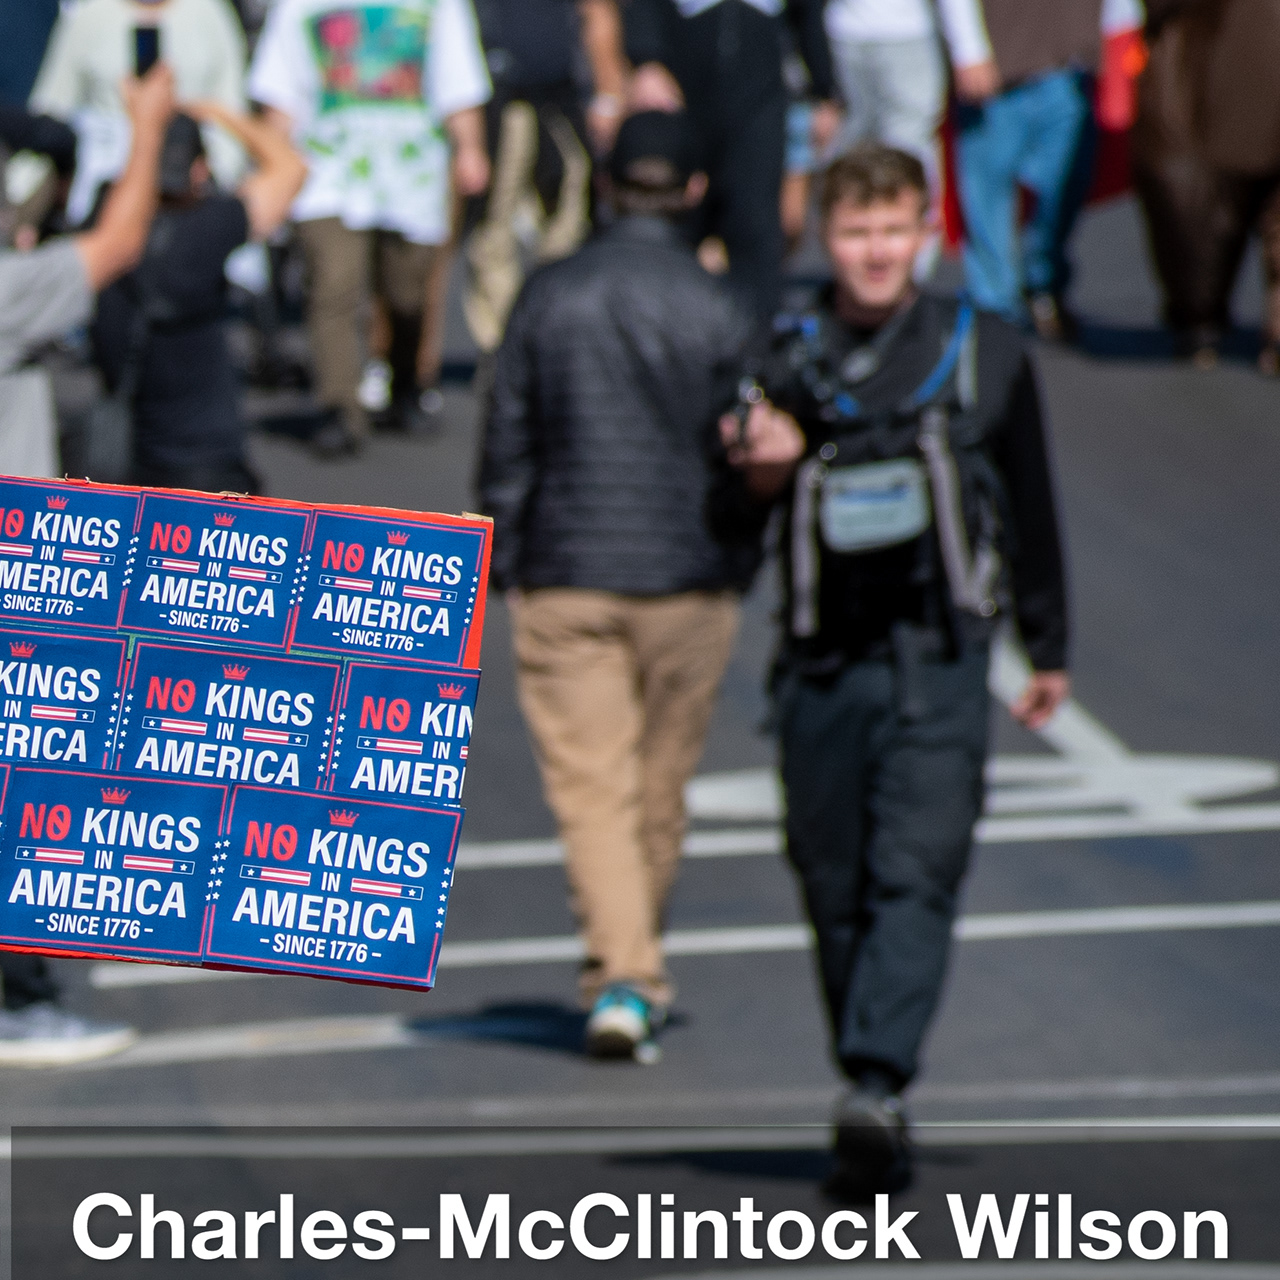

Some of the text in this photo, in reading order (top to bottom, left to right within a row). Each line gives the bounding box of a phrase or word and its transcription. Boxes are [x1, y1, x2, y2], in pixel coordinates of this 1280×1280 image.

[32, 512, 120, 549] KINGS
[198, 528, 288, 567] KINGS
[40, 545, 55, 560] IN
[207, 562, 221, 577] IN
[371, 547, 462, 586] KINGS
[140, 574, 276, 619] AMERICA
[380, 581, 395, 596] IN
[312, 592, 451, 637] AMERICA
[4, 701, 21, 718] IN
[204, 683, 314, 728] KINGS
[216, 722, 234, 740] IN
[433, 741, 450, 759] IN
[135, 736, 301, 786] AMERICA
[82, 808, 200, 852] KINGS
[95, 850, 113, 869] IN
[307, 829, 430, 879] KINGS
[8, 871, 186, 920] AMERICA
[321, 872, 340, 892] IN
[232, 887, 415, 946] AMERICA
